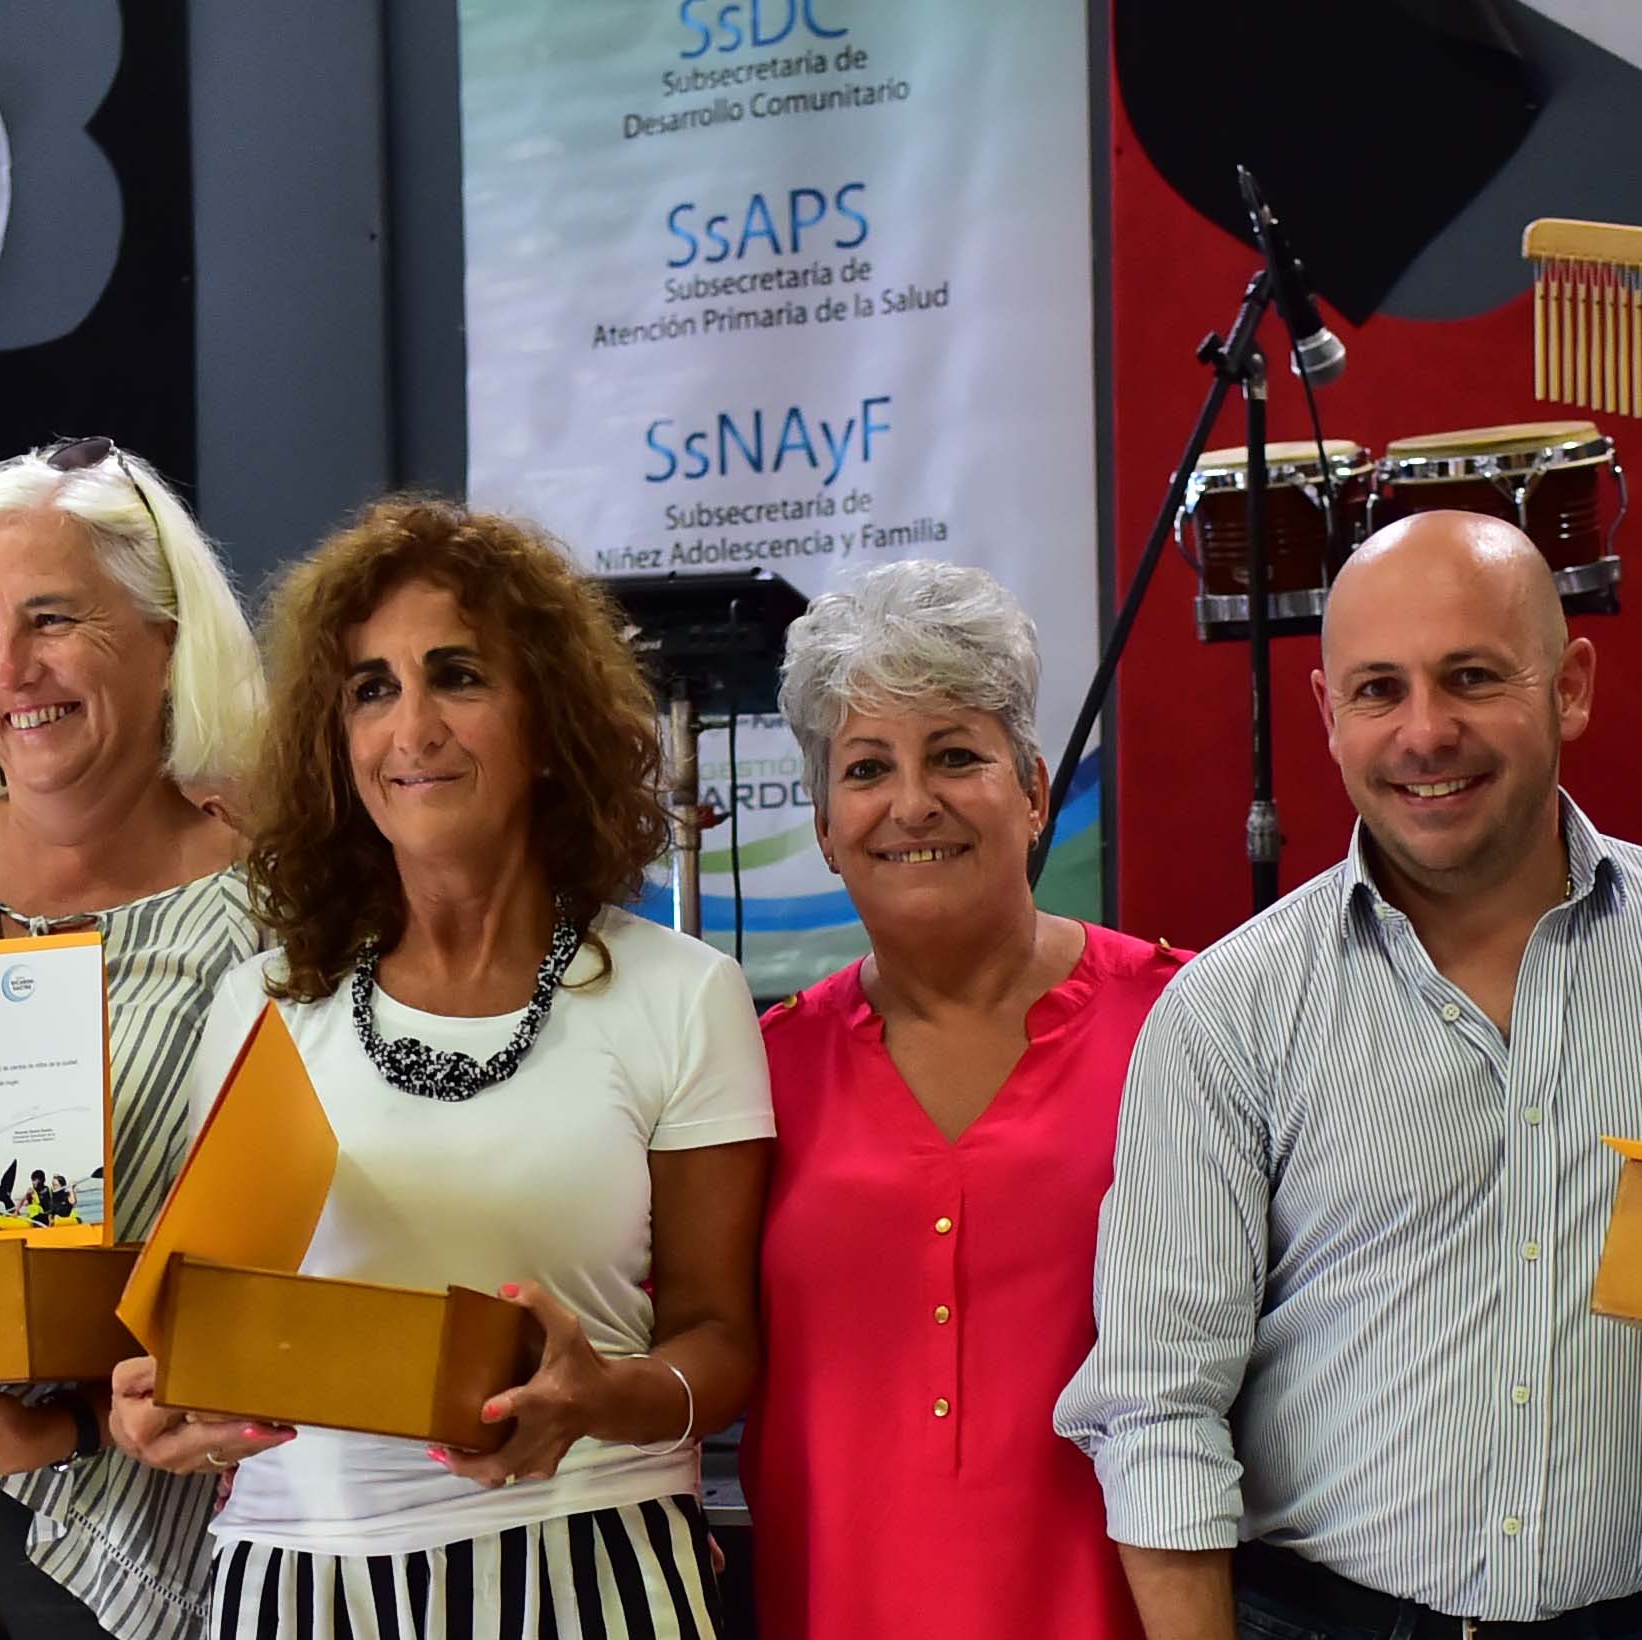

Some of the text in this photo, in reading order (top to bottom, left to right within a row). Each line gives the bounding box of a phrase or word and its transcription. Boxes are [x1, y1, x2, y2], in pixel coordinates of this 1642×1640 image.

[680, 0, 848, 59] SsDC
[835, 45, 869, 73] de
[623, 78, 910, 139] Desarrollo Comunitario
[666, 183, 869, 268] SsAPS
[841, 257, 873, 284] de
[591, 281, 950, 349] Atención Primaria de la Salud
[645, 396, 891, 486] SsNAyF
[842, 488, 873, 515] de
[595, 518, 949, 572] Niñez Adolescencia y Familia
[699, 749, 798, 781] GESTIÓ
